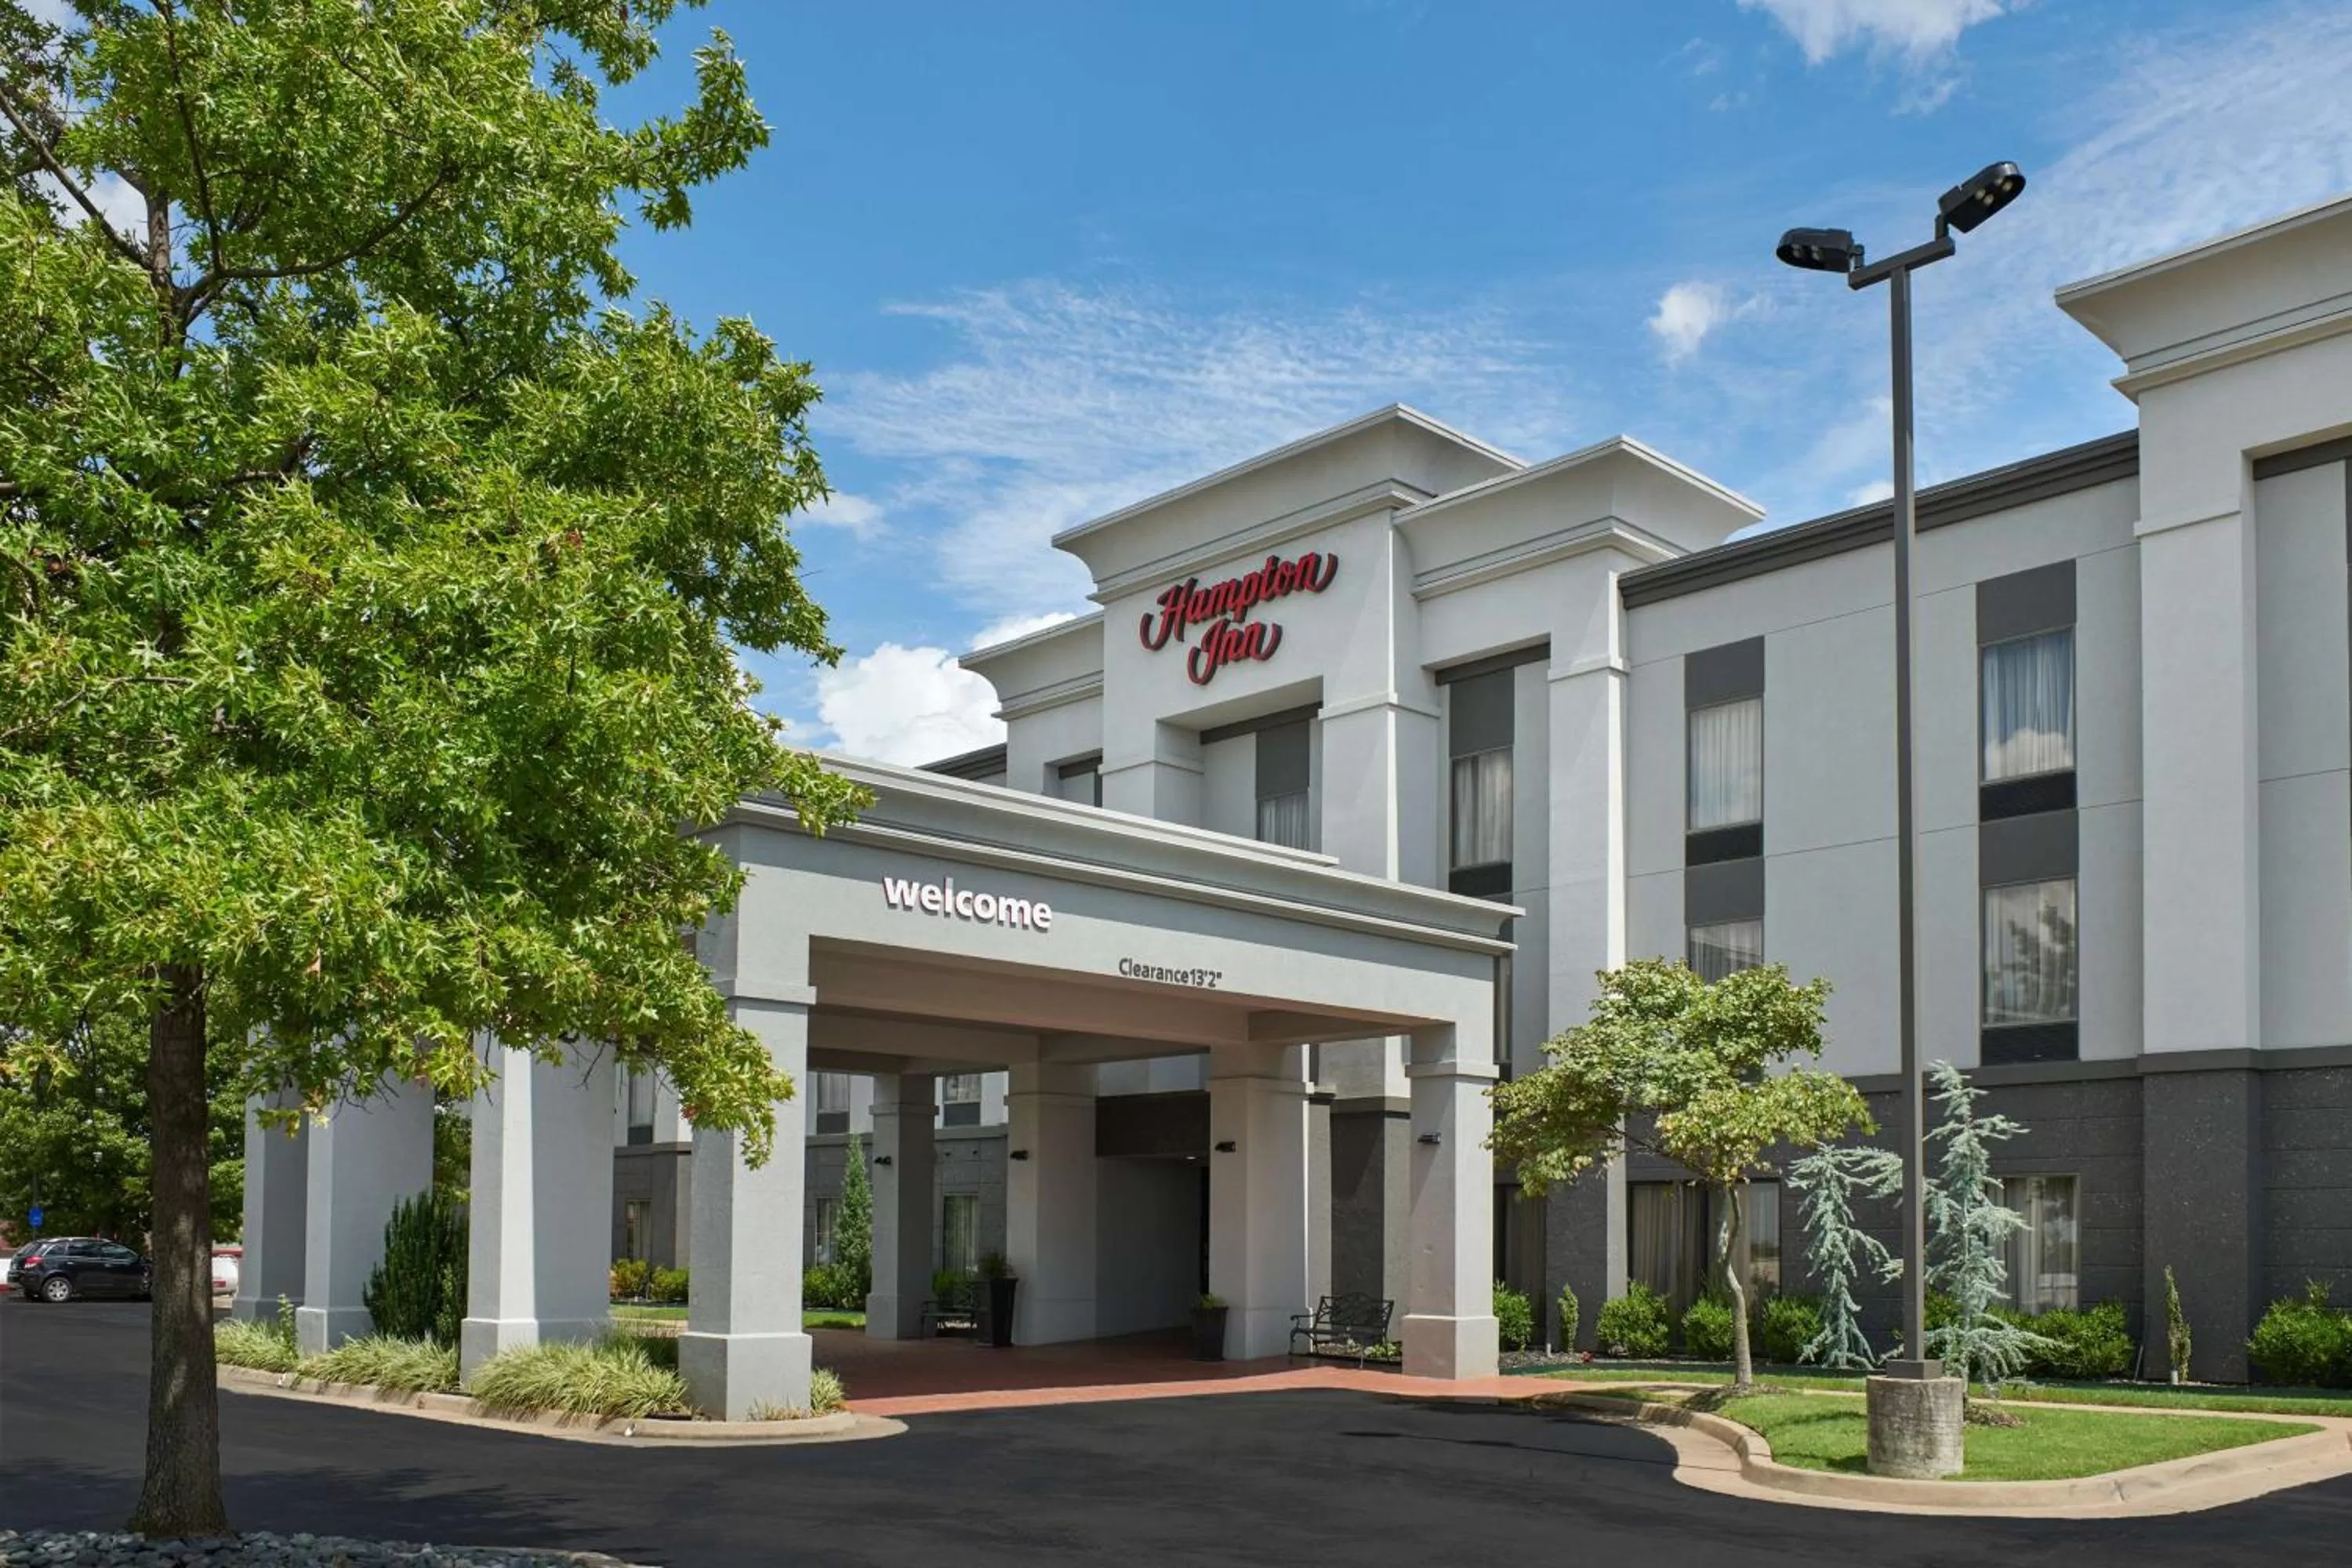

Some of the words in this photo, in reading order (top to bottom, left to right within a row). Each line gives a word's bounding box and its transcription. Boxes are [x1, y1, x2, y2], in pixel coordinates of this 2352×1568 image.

[1140, 551, 1338, 652] Hampton
[1186, 618, 1283, 685] Inn
[882, 877, 1053, 931] welcome
